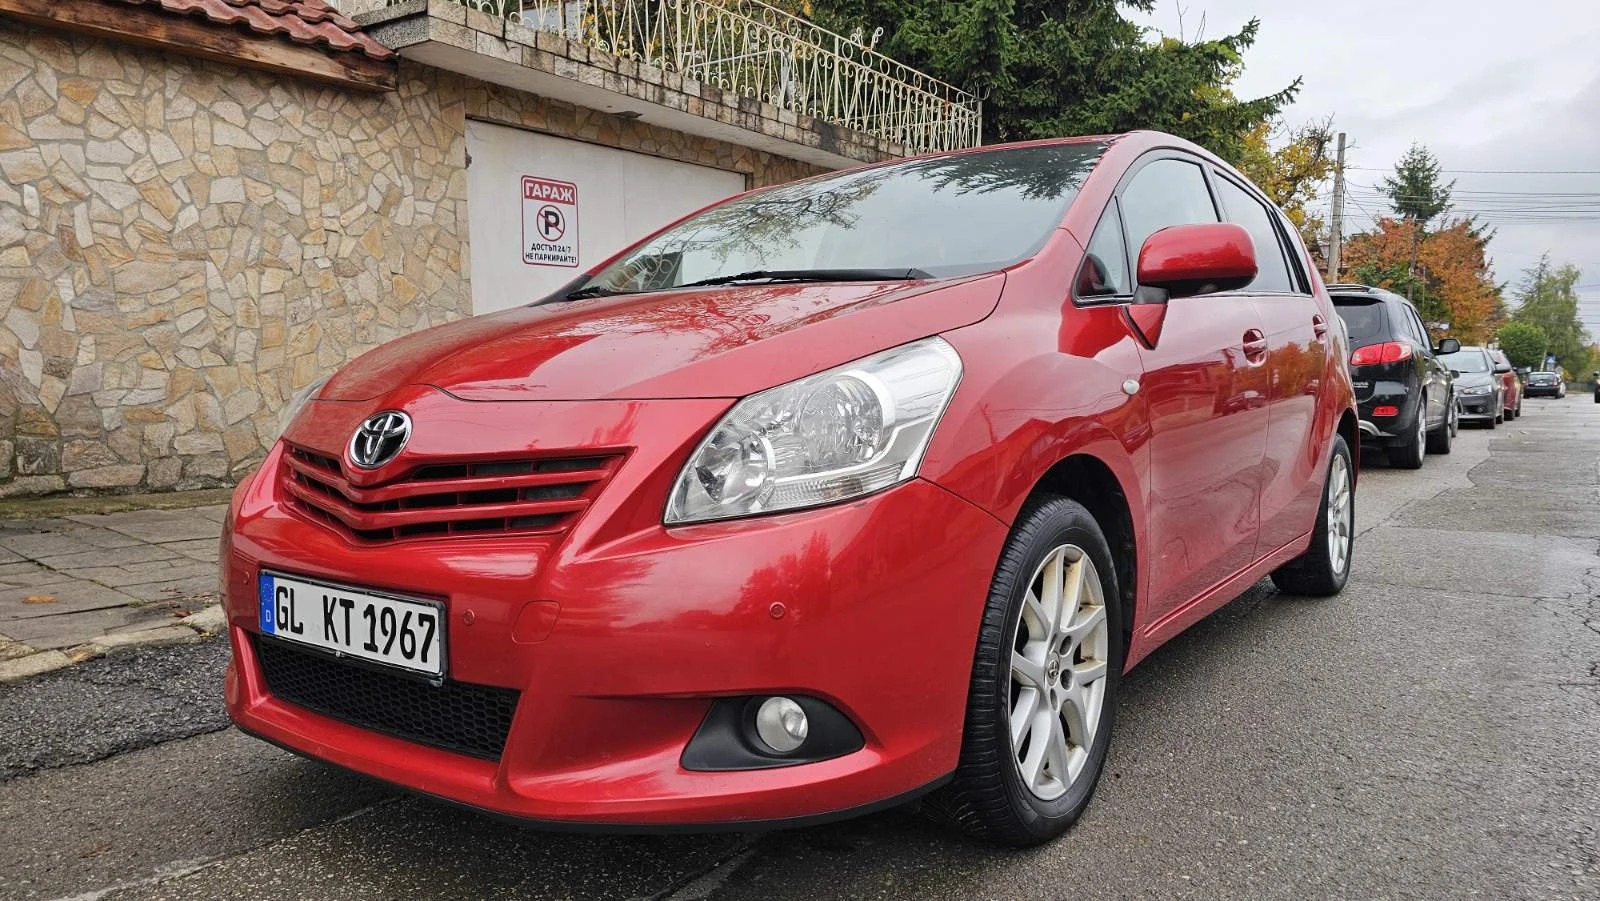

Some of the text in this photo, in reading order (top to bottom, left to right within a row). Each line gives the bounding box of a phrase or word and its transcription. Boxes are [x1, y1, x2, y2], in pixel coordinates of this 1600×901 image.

[525, 182, 574, 202] ГАРАЖ
[544, 210, 560, 235] P
[525, 252, 534, 260] НЕ
[531, 242, 571, 253] ДОСТЪП 24/7
[265, 609, 272, 623] D
[275, 585, 436, 663] GL KT 1967
